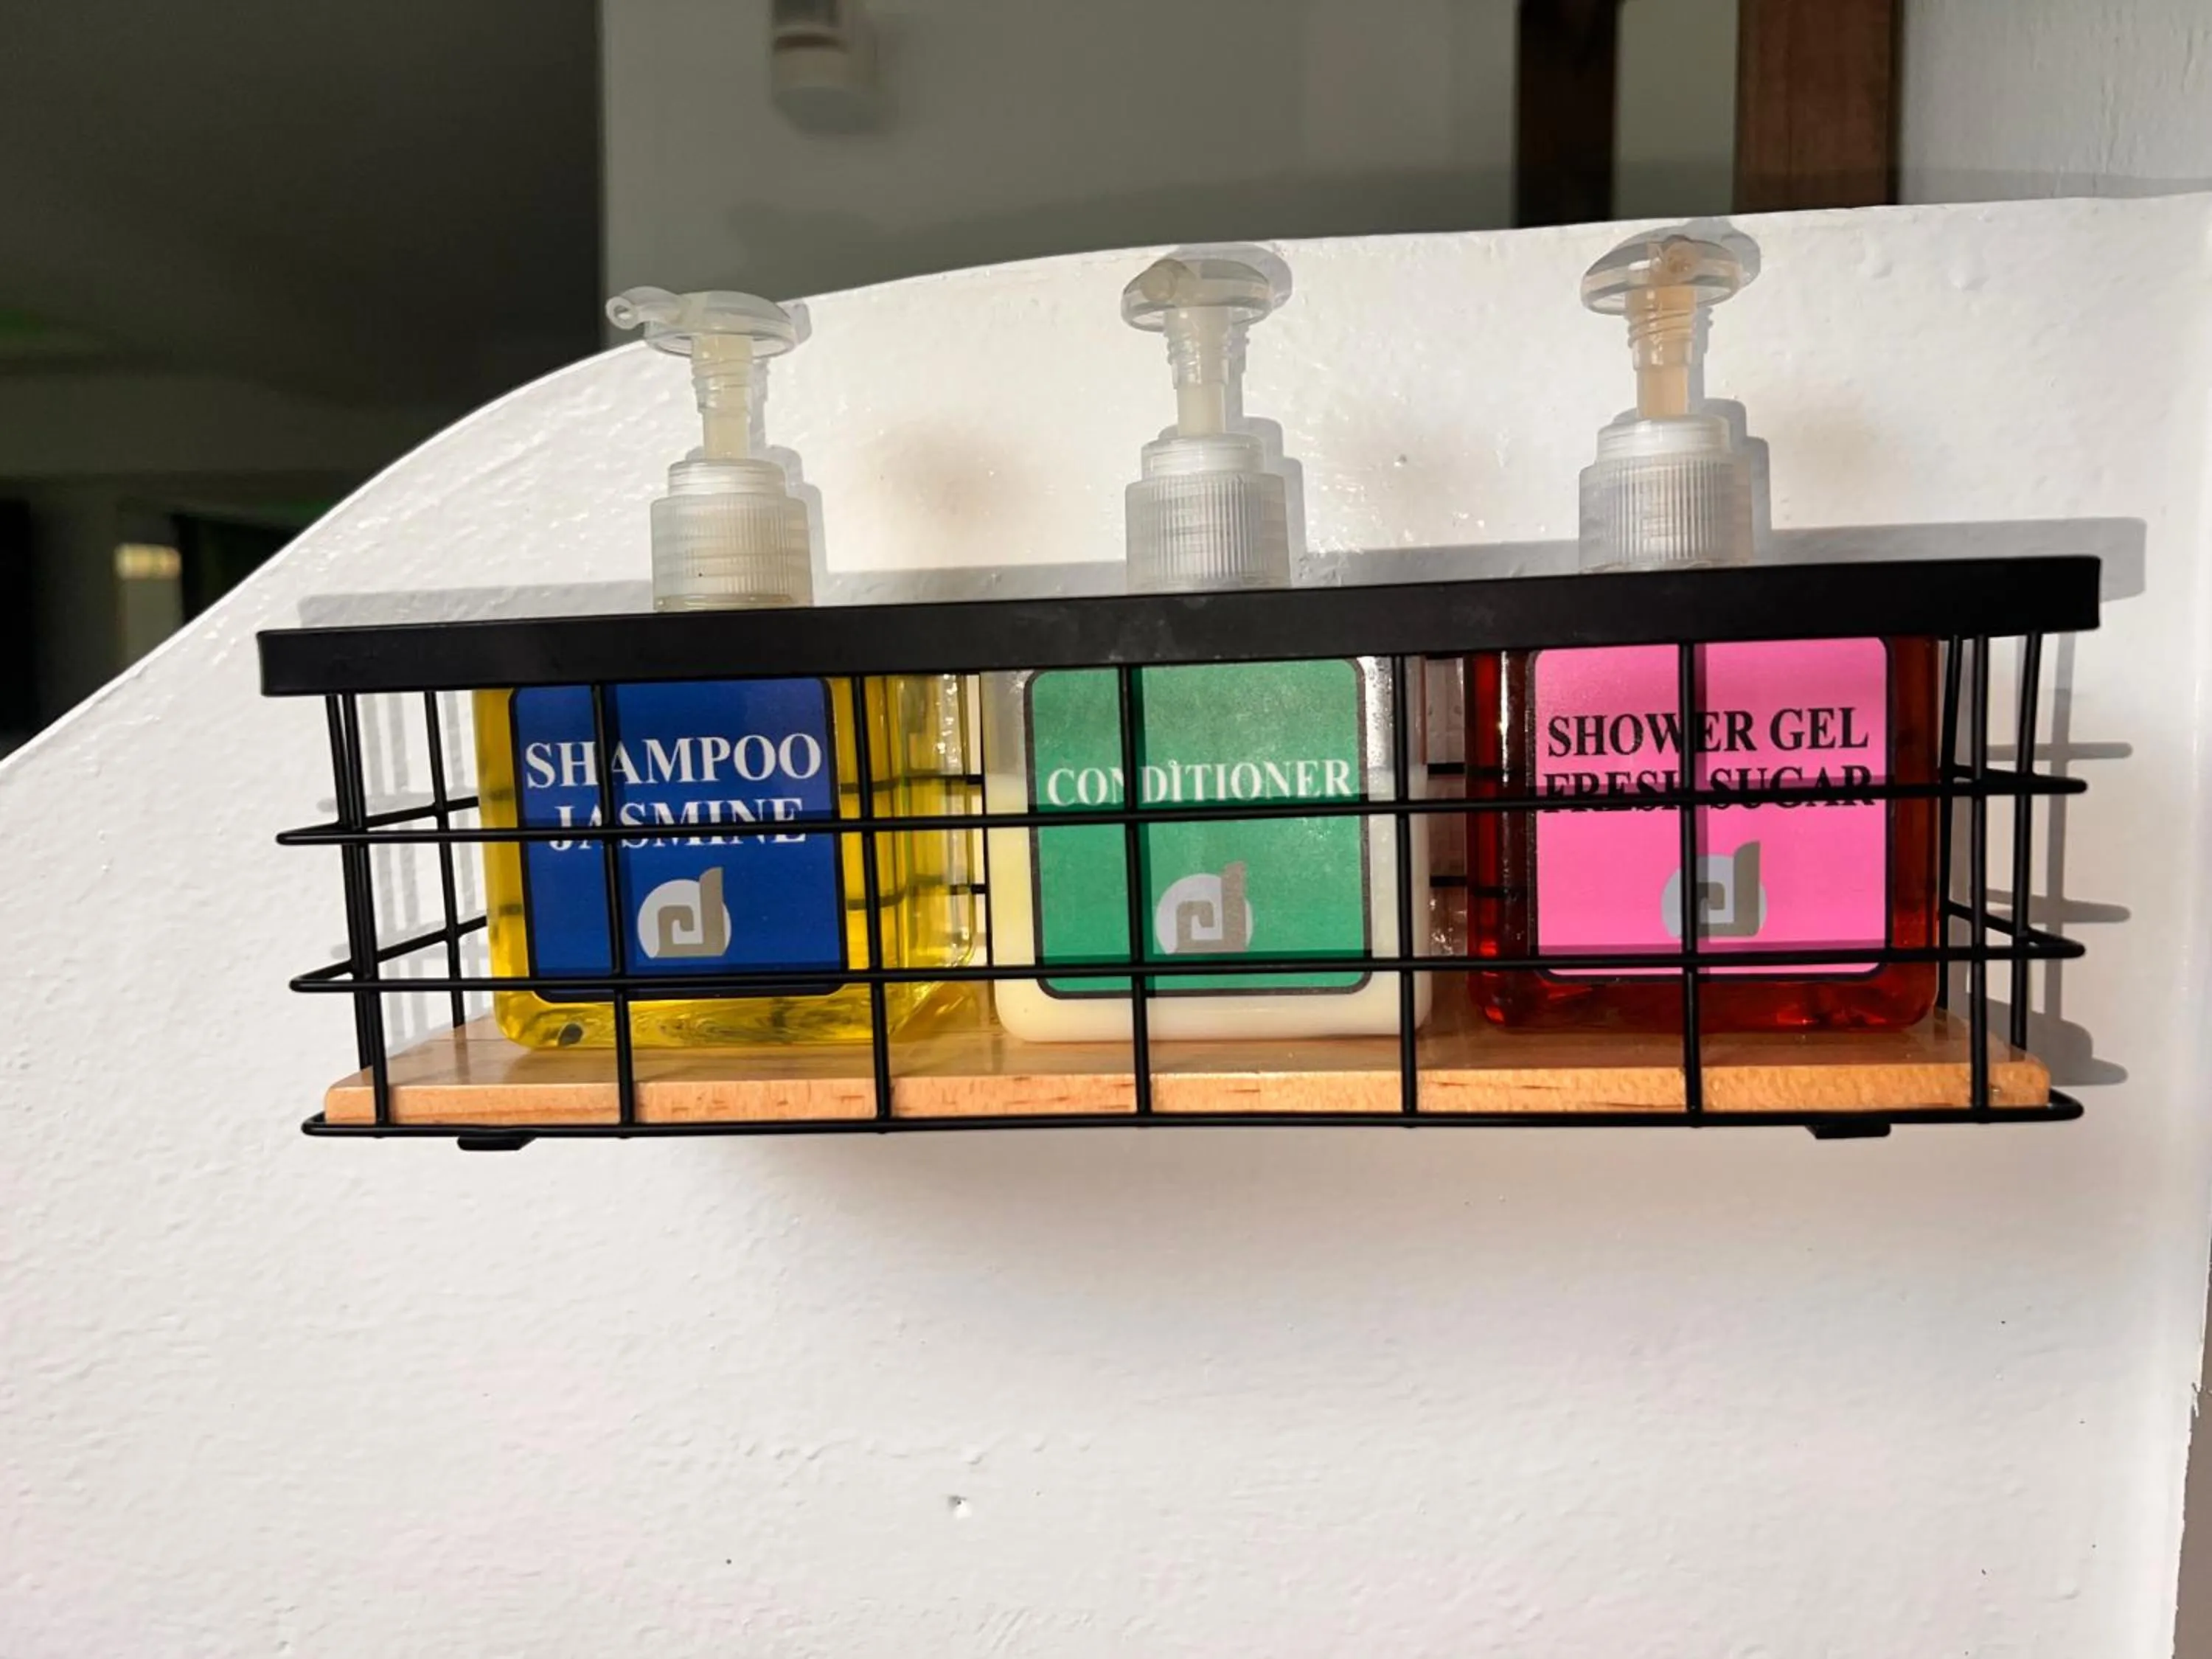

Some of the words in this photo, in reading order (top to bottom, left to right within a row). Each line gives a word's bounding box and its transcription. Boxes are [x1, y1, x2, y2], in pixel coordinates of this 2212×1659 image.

[1548, 710, 1757, 757] SHOWER
[1770, 707, 1869, 751] GEL
[526, 734, 821, 788] SHAMPOO
[1709, 765, 1876, 810] SUGAR
